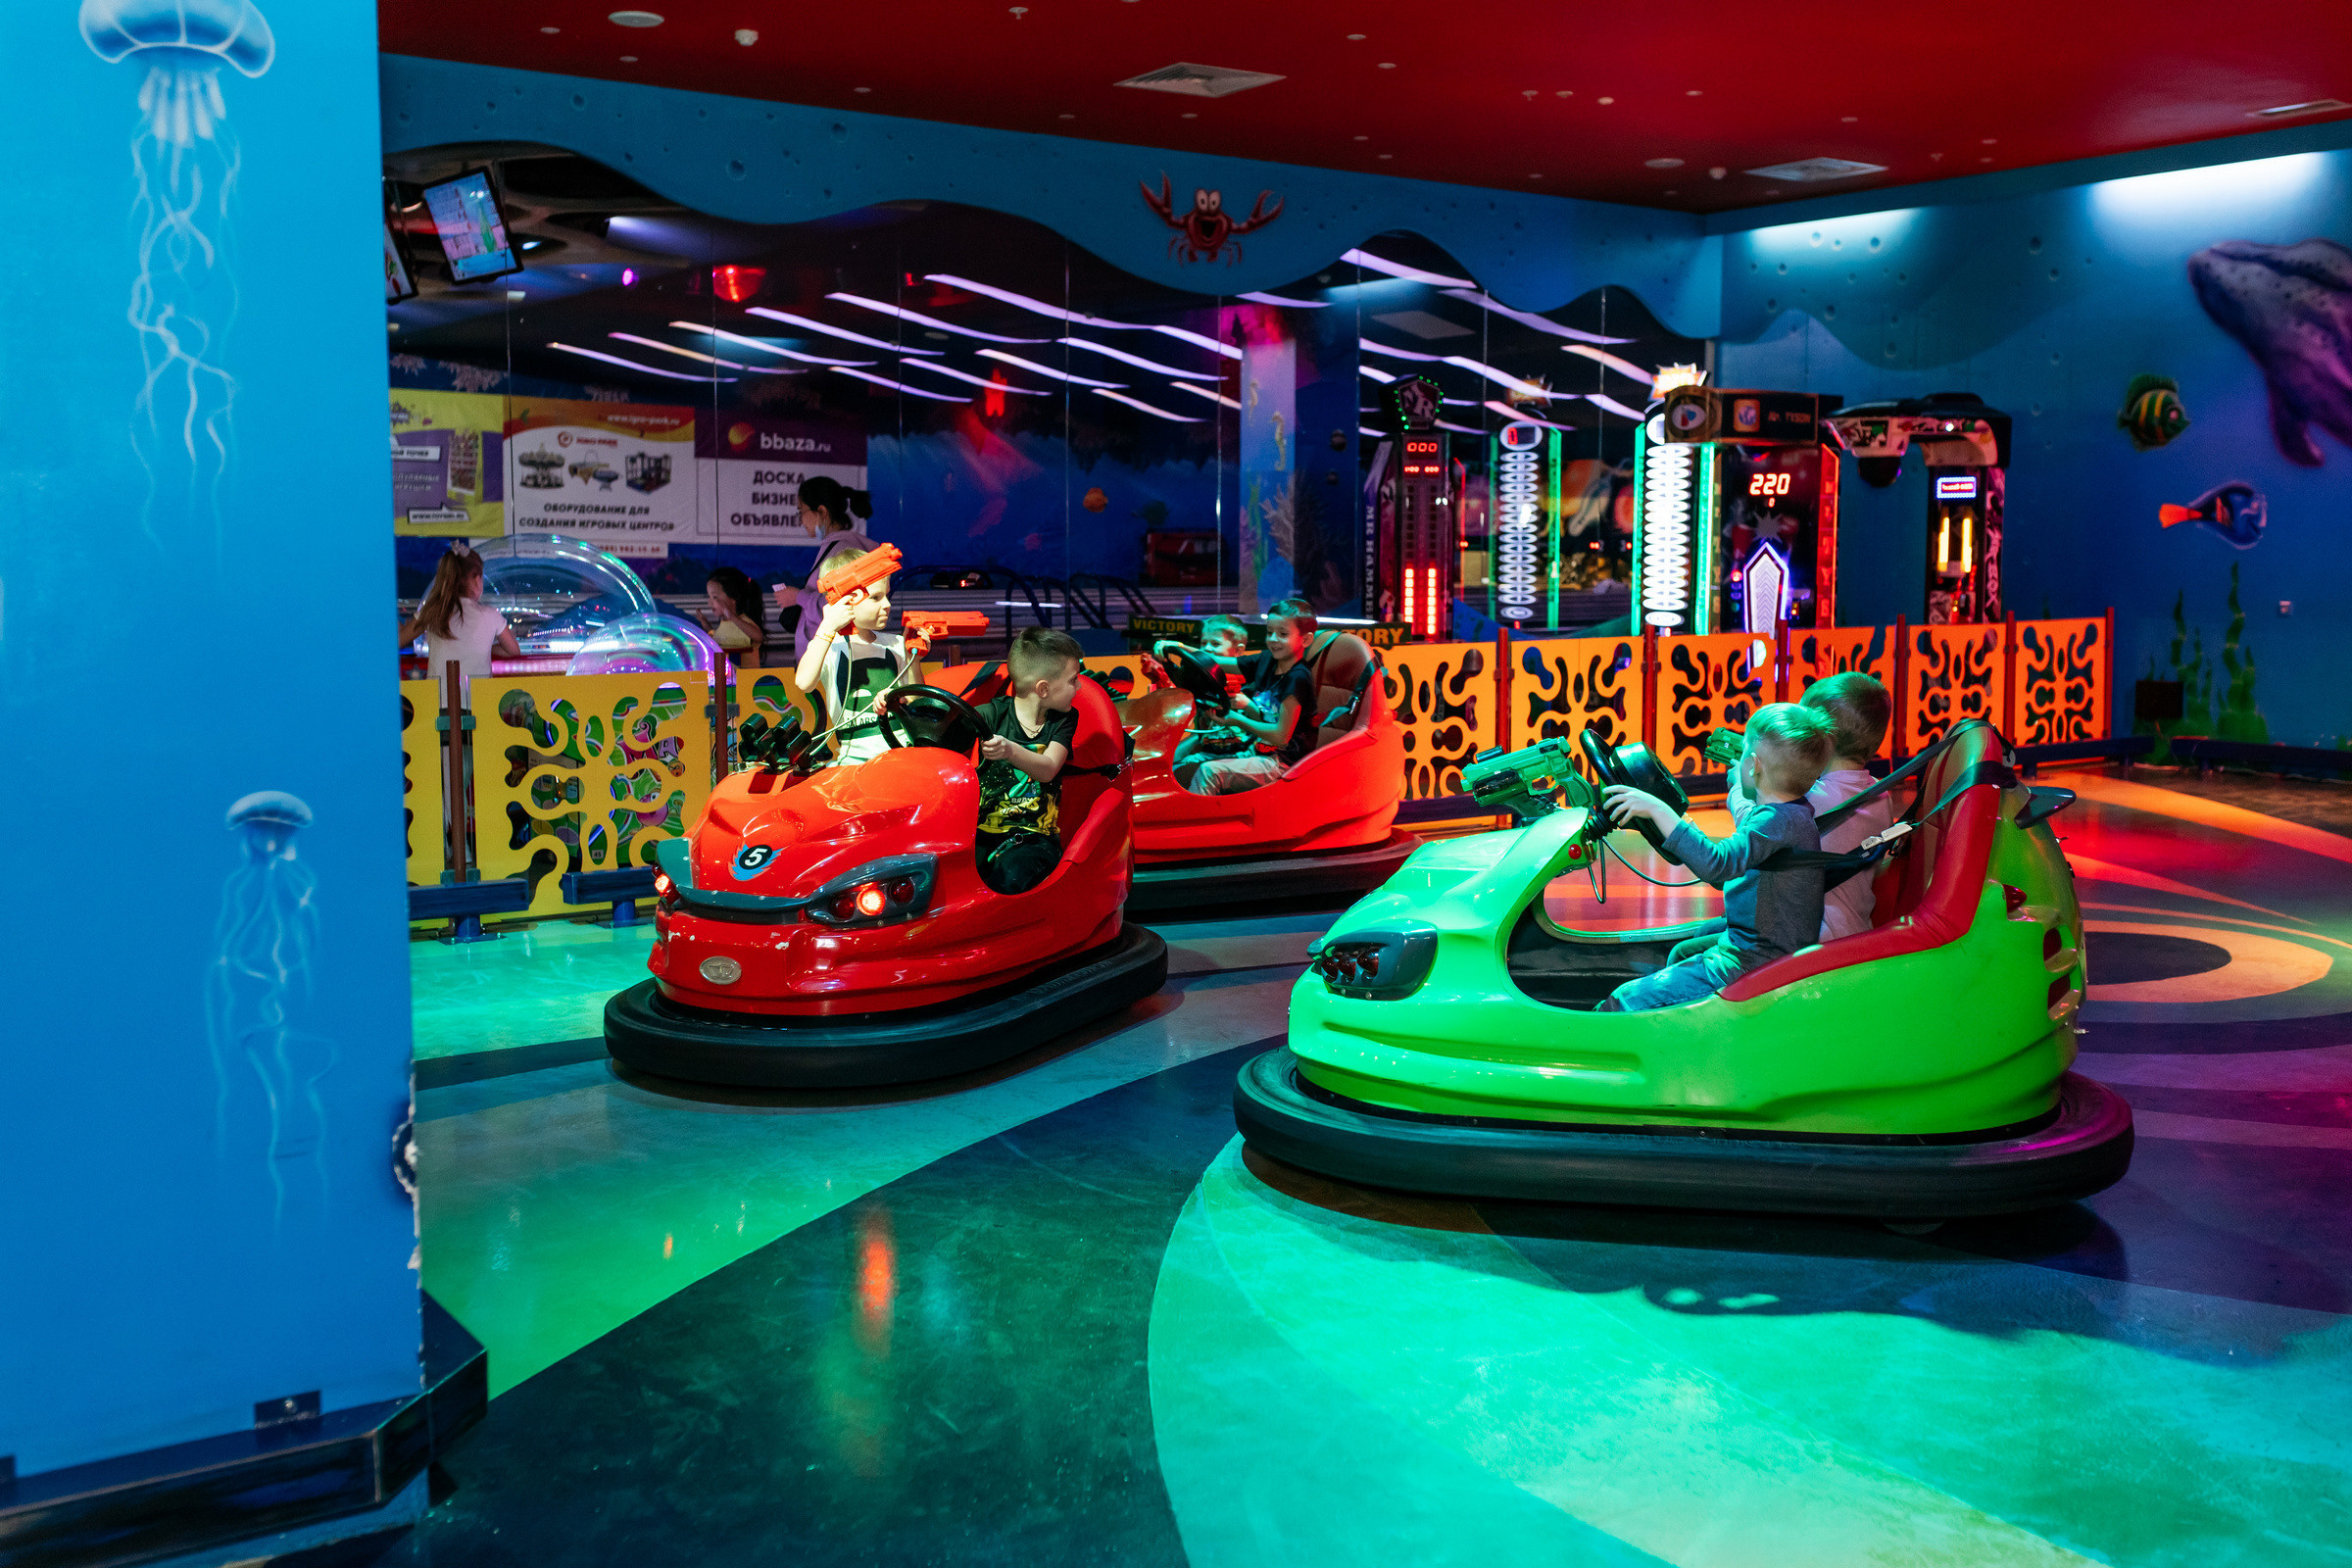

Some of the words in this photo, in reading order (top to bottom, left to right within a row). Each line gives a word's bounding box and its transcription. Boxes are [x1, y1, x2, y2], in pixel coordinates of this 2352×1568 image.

[760, 432, 831, 453] bbaza.ru
[753, 470, 806, 485] ДОСКА
[1749, 473, 1790, 495] 220
[751, 492, 799, 506] БИЗНЕ
[544, 503, 626, 514] ОБОРУДОВАНИЕ
[628, 505, 650, 515] ДЛЯ
[518, 517, 576, 528] СОЗДАНИЯ
[578, 518, 626, 529] ИГРОВЫХ
[628, 520, 674, 531] ЦЕНТРОВ
[730, 513, 803, 527] ОБЪЯВЛЕ
[1132, 617, 1196, 635] VICTORY
[747, 848, 768, 867] 5
